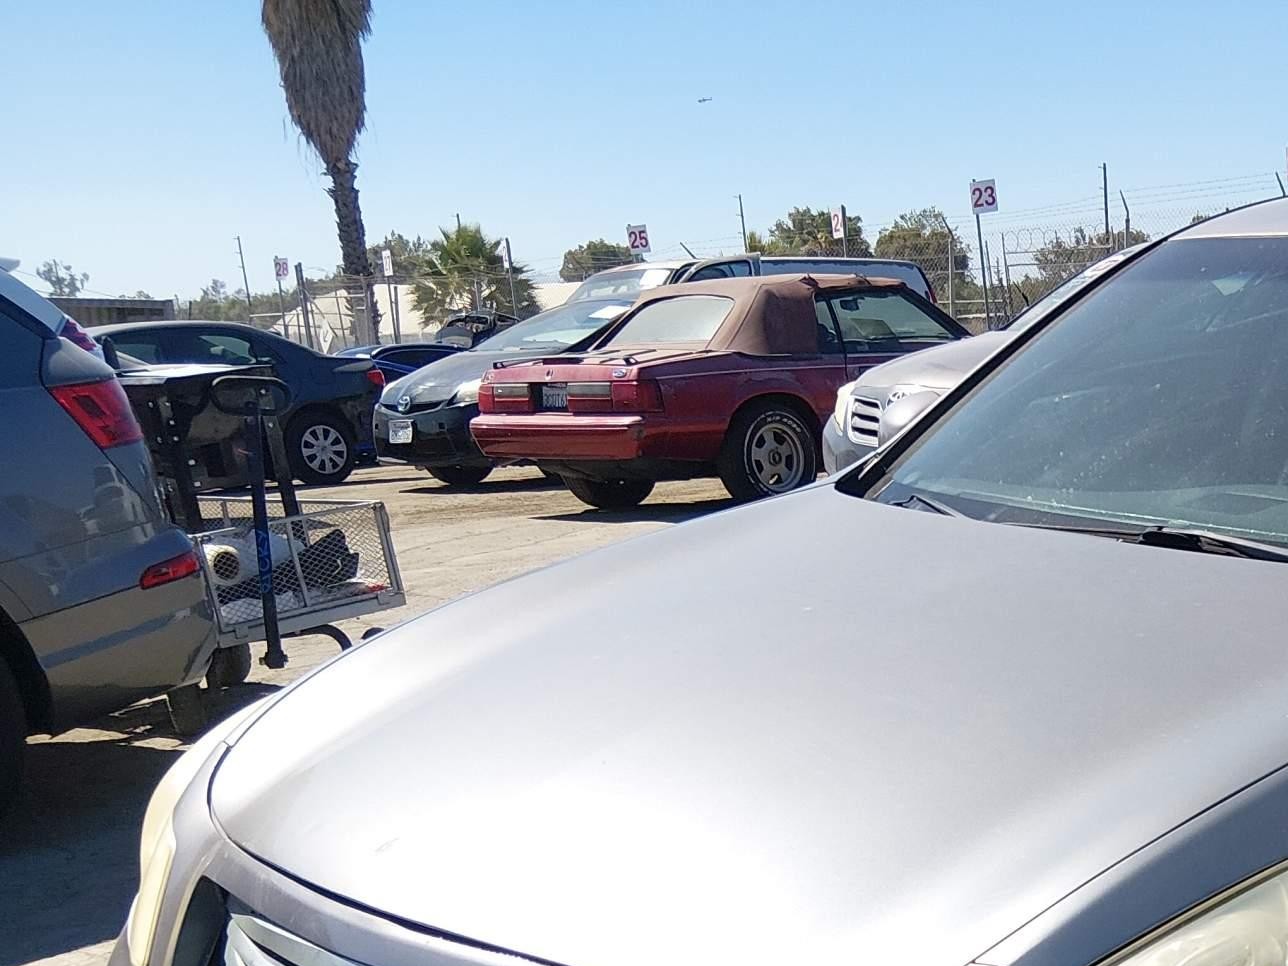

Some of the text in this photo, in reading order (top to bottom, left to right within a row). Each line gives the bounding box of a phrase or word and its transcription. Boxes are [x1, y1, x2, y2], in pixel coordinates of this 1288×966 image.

[972, 187, 996, 208] 23
[629, 231, 648, 248] 25
[275, 262, 288, 276] 28
